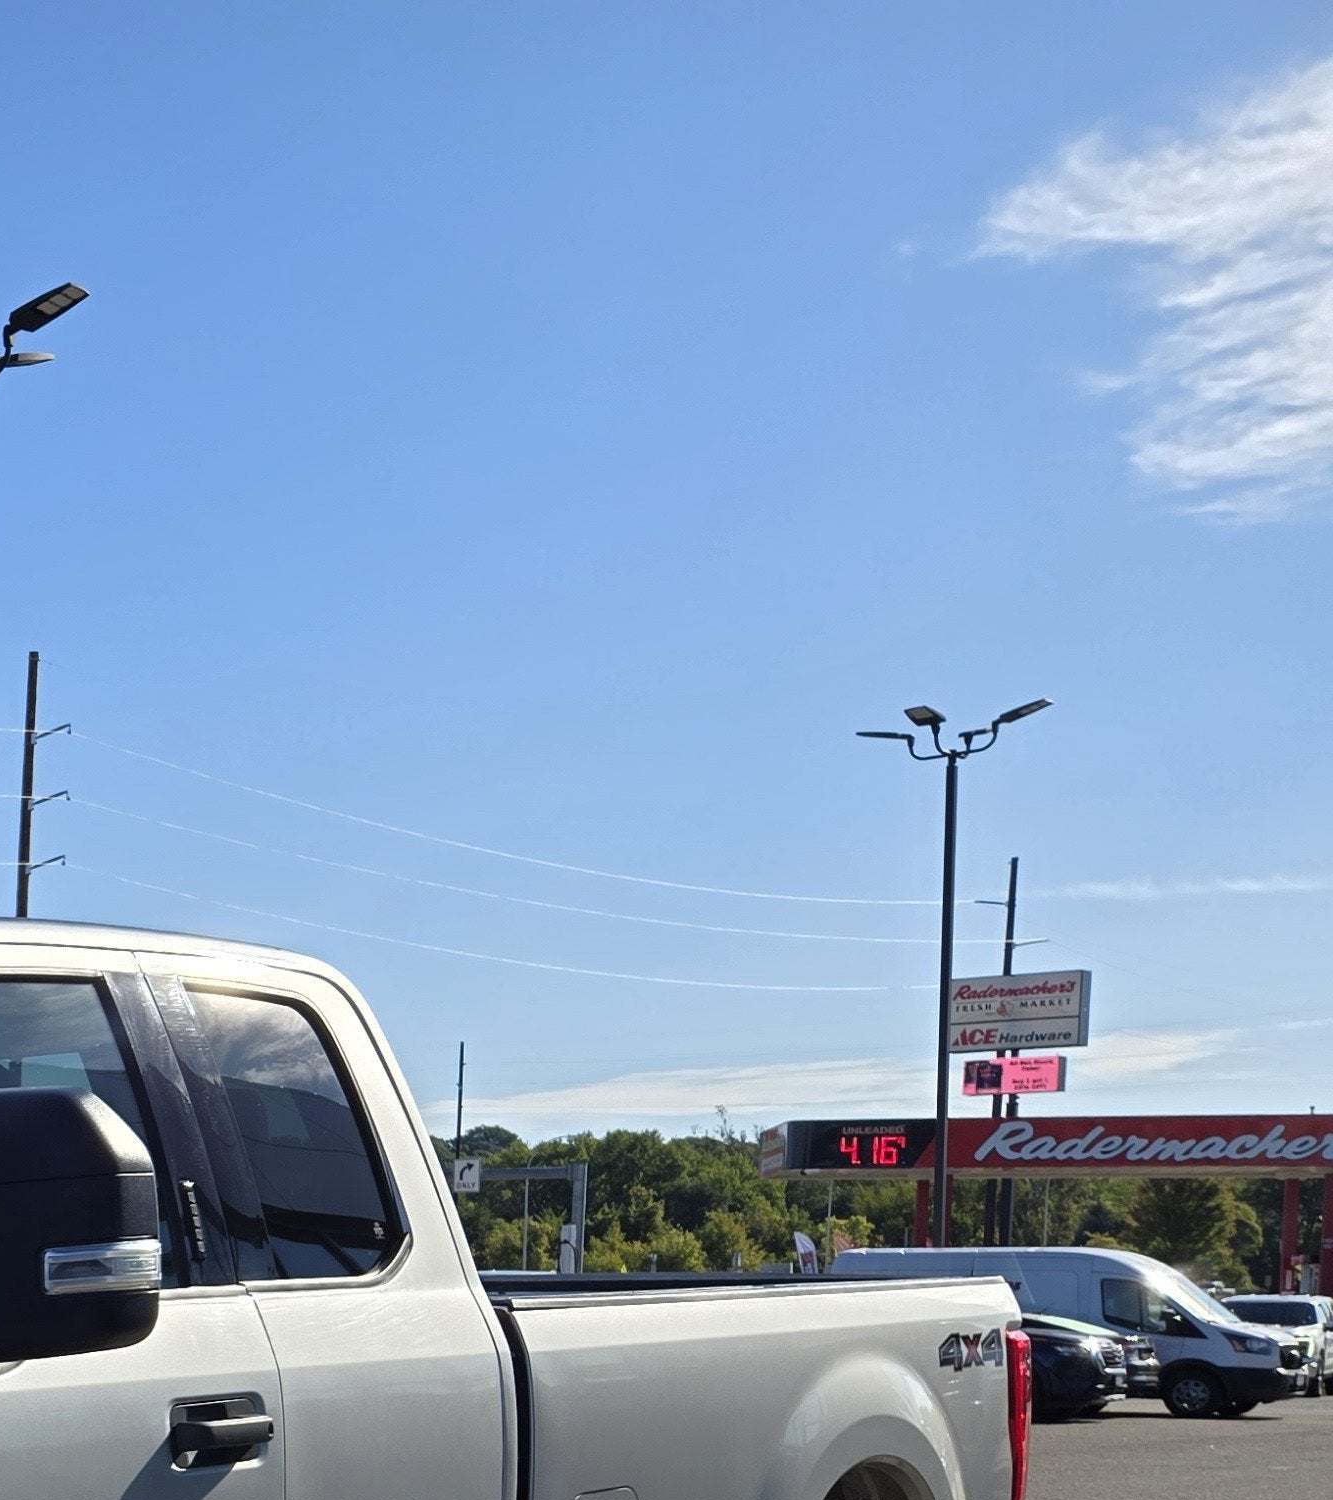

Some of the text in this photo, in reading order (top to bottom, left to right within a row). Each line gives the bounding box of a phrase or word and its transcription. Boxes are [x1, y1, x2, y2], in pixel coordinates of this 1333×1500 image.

[953, 980, 1076, 1001] Radermacher's
[956, 998, 1071, 1012] FRESH MARKET
[952, 1027, 1072, 1046] ACE Hardware
[842, 1126, 905, 1135] UNLEADED
[456, 1181, 476, 1189] ONLY
